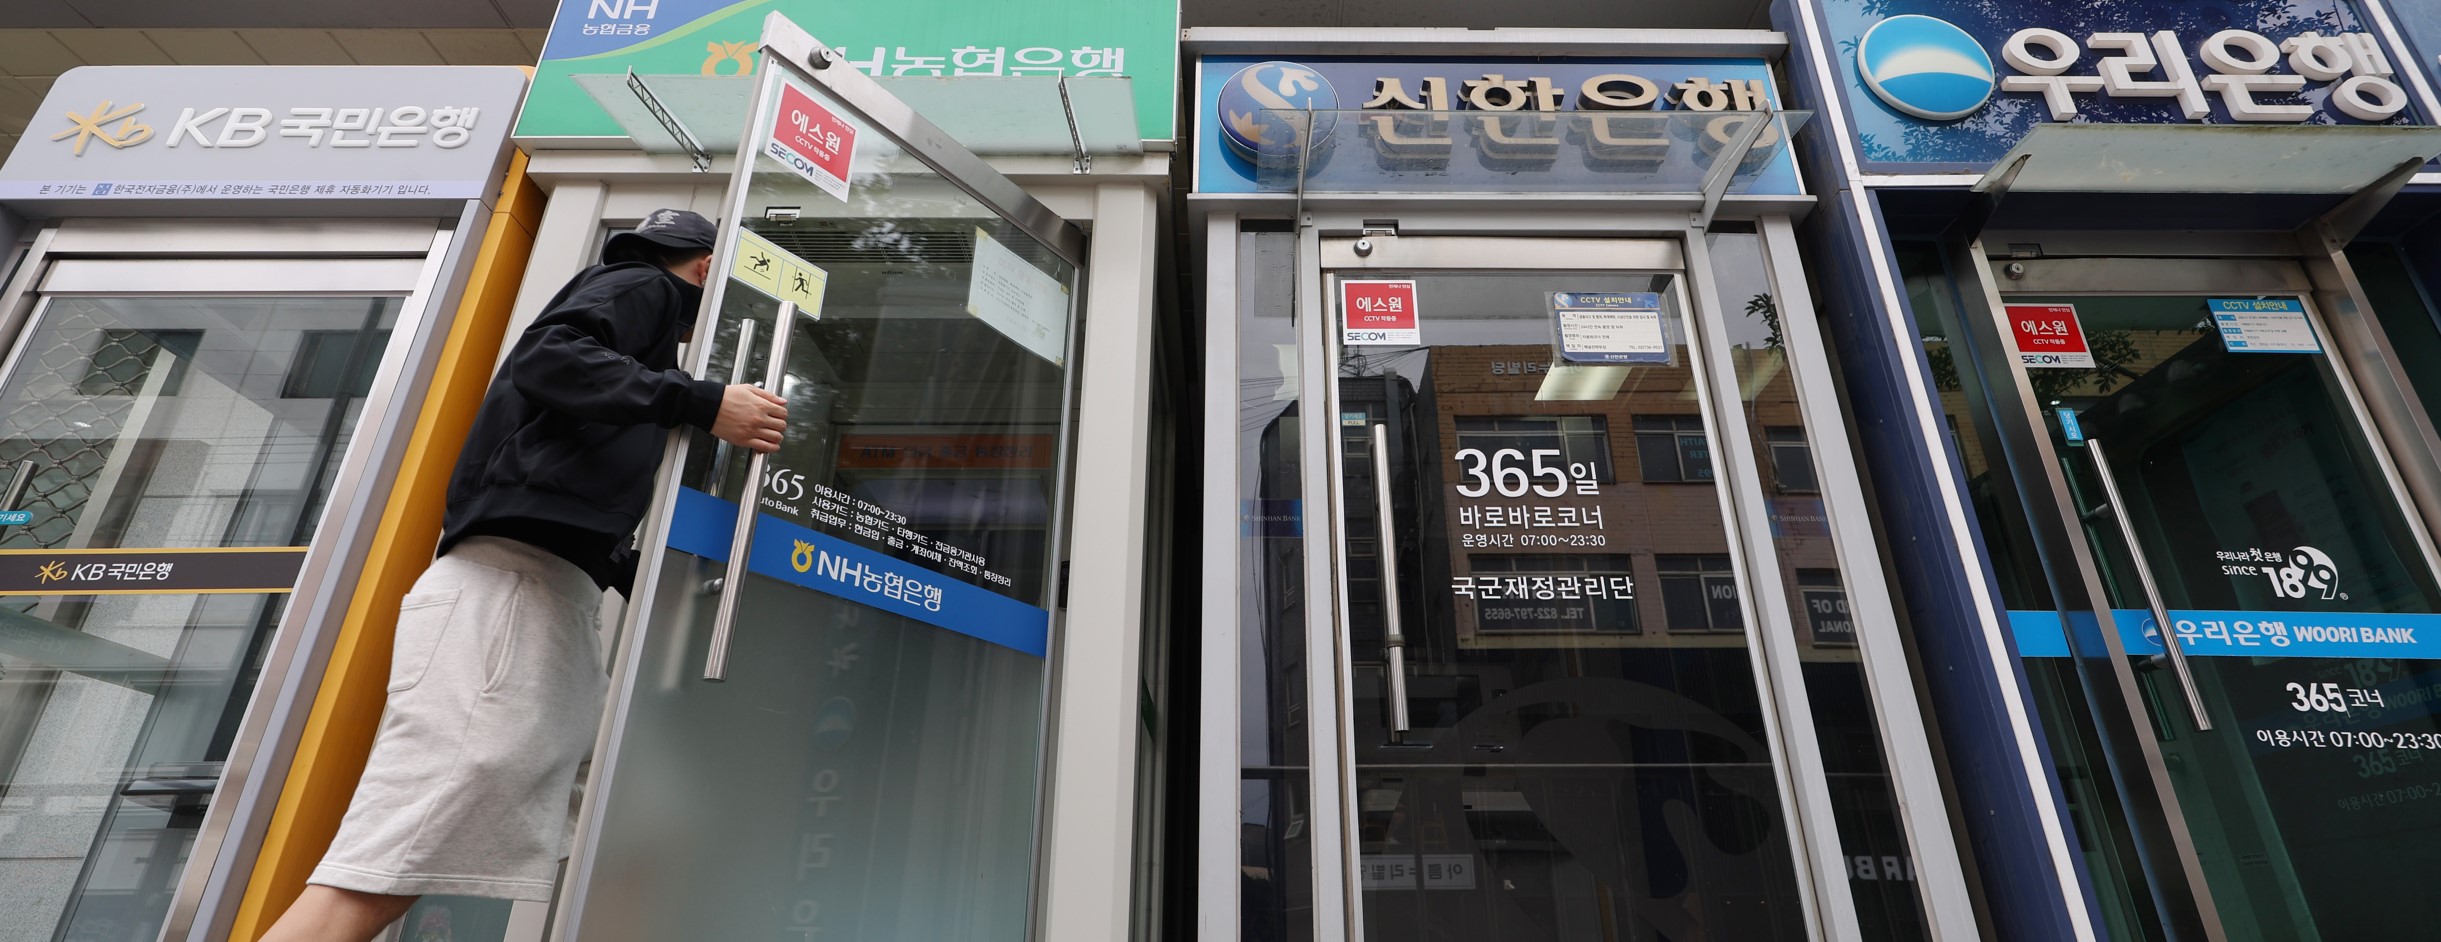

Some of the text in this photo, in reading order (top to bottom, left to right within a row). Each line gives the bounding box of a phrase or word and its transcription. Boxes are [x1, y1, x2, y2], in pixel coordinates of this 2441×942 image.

[582, 23, 651, 36] 농협금융
[2000, 27, 2408, 122] 우리은행
[1359, 73, 1781, 160] 신한은행
[791, 109, 841, 155] 에스원
[795, 135, 813, 150] CCTV
[770, 142, 815, 177] SECOM
[39, 184, 51, 195] 본
[54, 184, 87, 195] 기기는
[113, 184, 219, 195] 한국전자금융(주)에서
[220, 184, 264, 195] 운영하는
[267, 184, 312, 195] 국민은행
[314, 184, 337, 195] 제휴
[339, 184, 395, 195] 자동화기기
[397, 184, 431, 195] 입니다.
[1356, 296, 1402, 312] 에스원
[2223, 301, 2250, 310] CCTV
[1347, 332, 1386, 341] SECOM
[2021, 320, 2069, 336] 에스원
[2021, 355, 2061, 364] SECOM
[1454, 448, 1600, 498] 365일
[775, 500, 799, 517] Bank
[814, 484, 907, 525] 이용시간 07:00~23:30
[1459, 505, 1604, 530] 바로바로코너
[812, 496, 986, 567] 사용카드 농협카드 타행카드 전금융기관사용
[1461, 533, 1606, 548] 운영시간 07:00~23:30
[810, 508, 847, 529] 취급업무
[887, 535, 904, 549] 출금
[911, 543, 943, 563] 계좌이체
[948, 557, 978, 576] 잔액조회
[984, 570, 1012, 588] 통장정리
[2216, 547, 2283, 563] 우리나라 첫 은행
[2221, 565, 2259, 576] since
[817, 550, 943, 613] NH농협은행
[1451, 576, 1635, 600] 국군재정관리단
[2175, 619, 2418, 648] 우리은행 WOORI BANK
[2286, 682, 2385, 712] 365 코너
[2256, 729, 2327, 748] 이용시간
